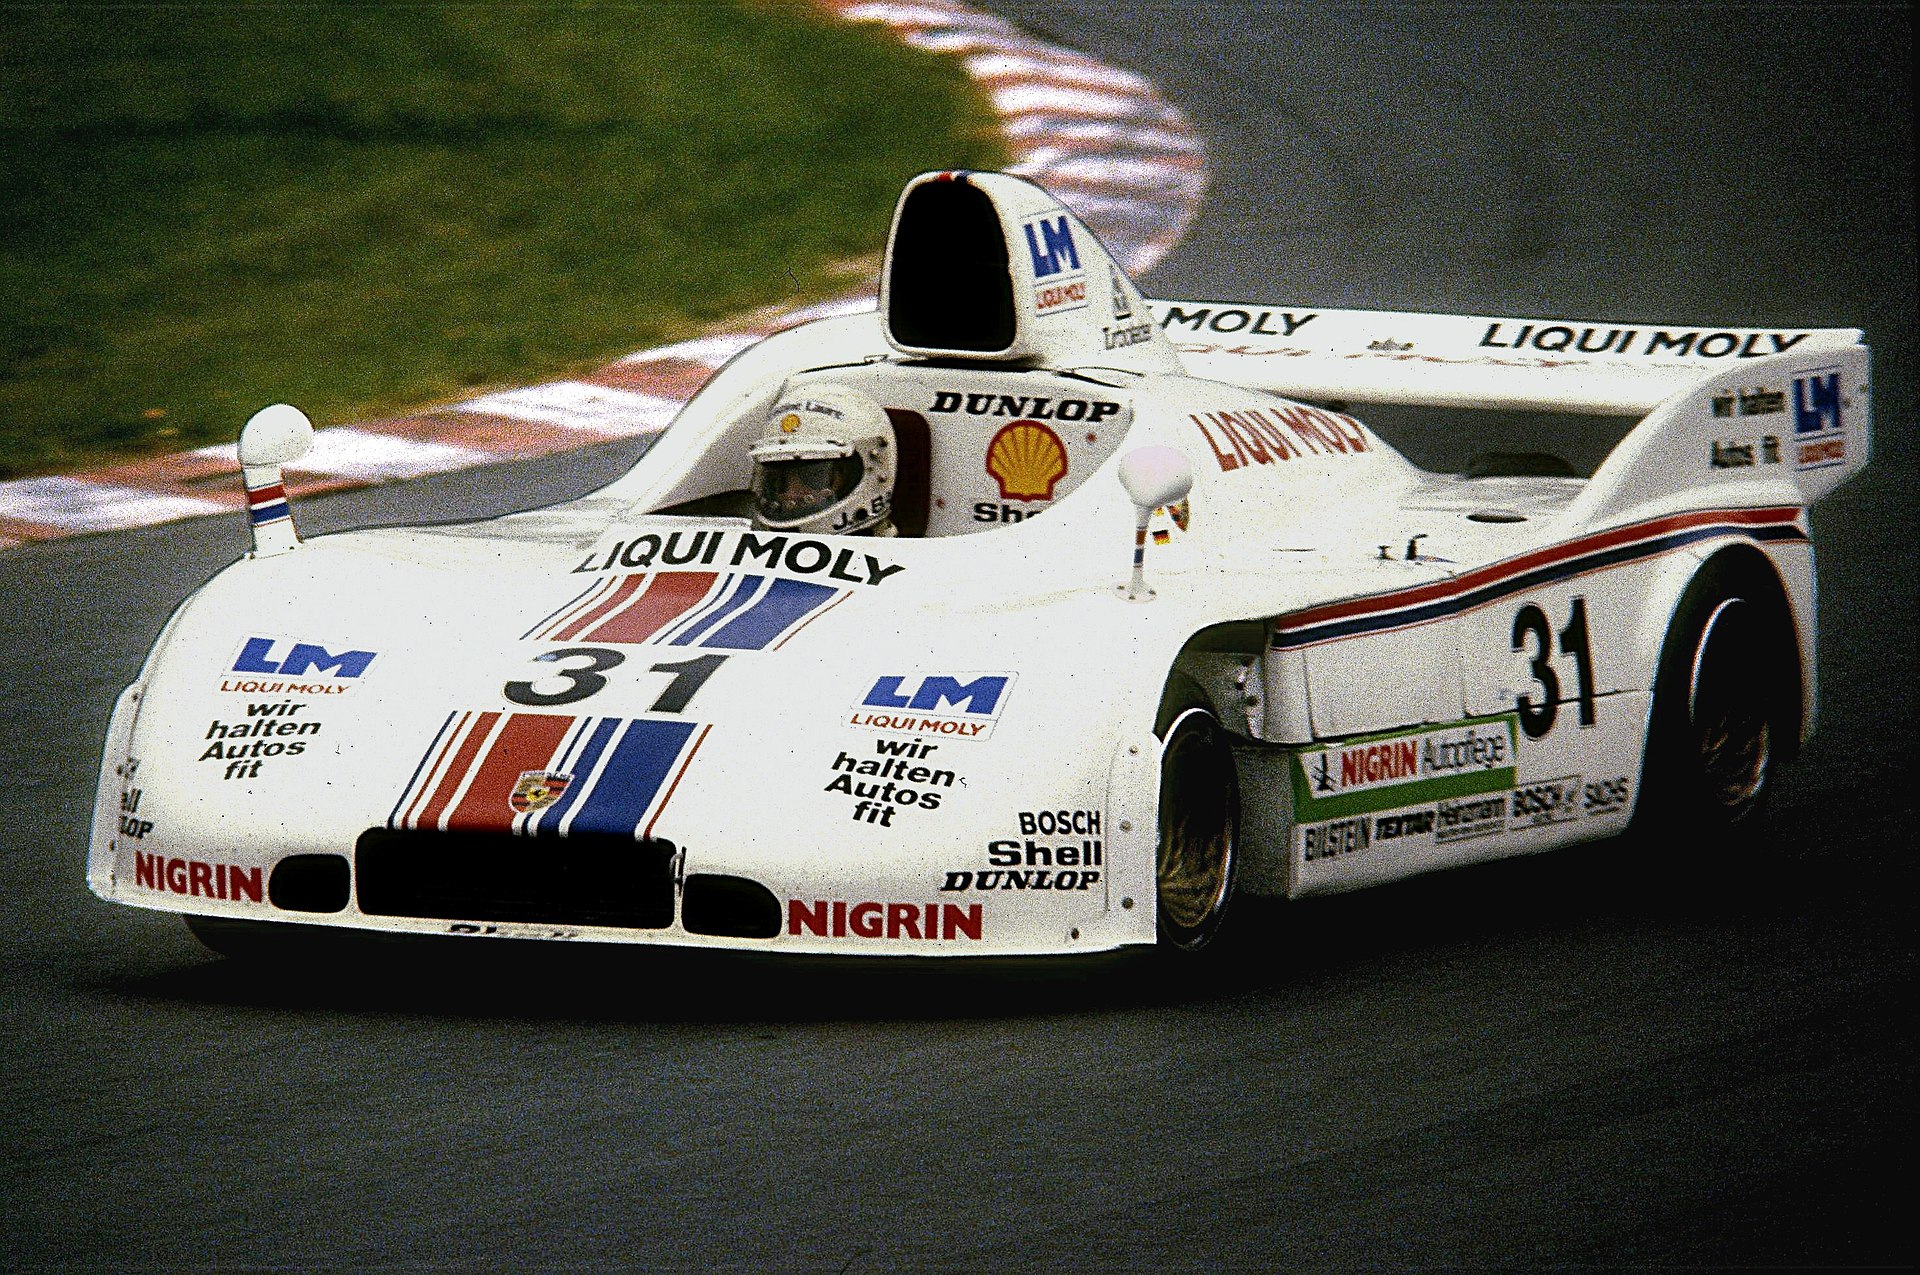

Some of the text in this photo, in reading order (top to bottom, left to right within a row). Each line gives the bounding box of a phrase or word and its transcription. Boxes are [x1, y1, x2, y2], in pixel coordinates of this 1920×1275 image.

[1024, 215, 1080, 277] LM
[1160, 306, 1318, 336] MOLY
[1478, 323, 1810, 358] LIQUI MOLY
[929, 391, 1119, 422] DUNLOP
[1792, 373, 1841, 434] LM
[1189, 410, 1302, 471] LIQUI
[570, 531, 907, 586] LIQUI MOLY
[231, 637, 379, 679] LM
[1511, 595, 1596, 740] 31
[219, 680, 351, 695] LIQUI MOLY
[503, 647, 731, 714] 31
[861, 675, 1009, 715] LM
[247, 699, 307, 717] wir
[850, 712, 987, 737] LIQUI MOLY
[204, 718, 321, 740] halten
[198, 739, 306, 761] Autos
[876, 738, 938, 760] wir
[1341, 740, 1418, 787] NIGRIN
[223, 760, 263, 780] fit
[831, 752, 955, 787] halten
[824, 774, 942, 810] Autos
[852, 801, 897, 828] fit
[1019, 810, 1101, 835] BOSCH
[988, 840, 1102, 866] Shell
[134, 850, 263, 903] NIGRIN
[940, 870, 1101, 891] DUNLOP
[788, 900, 983, 940] NIGRIN
